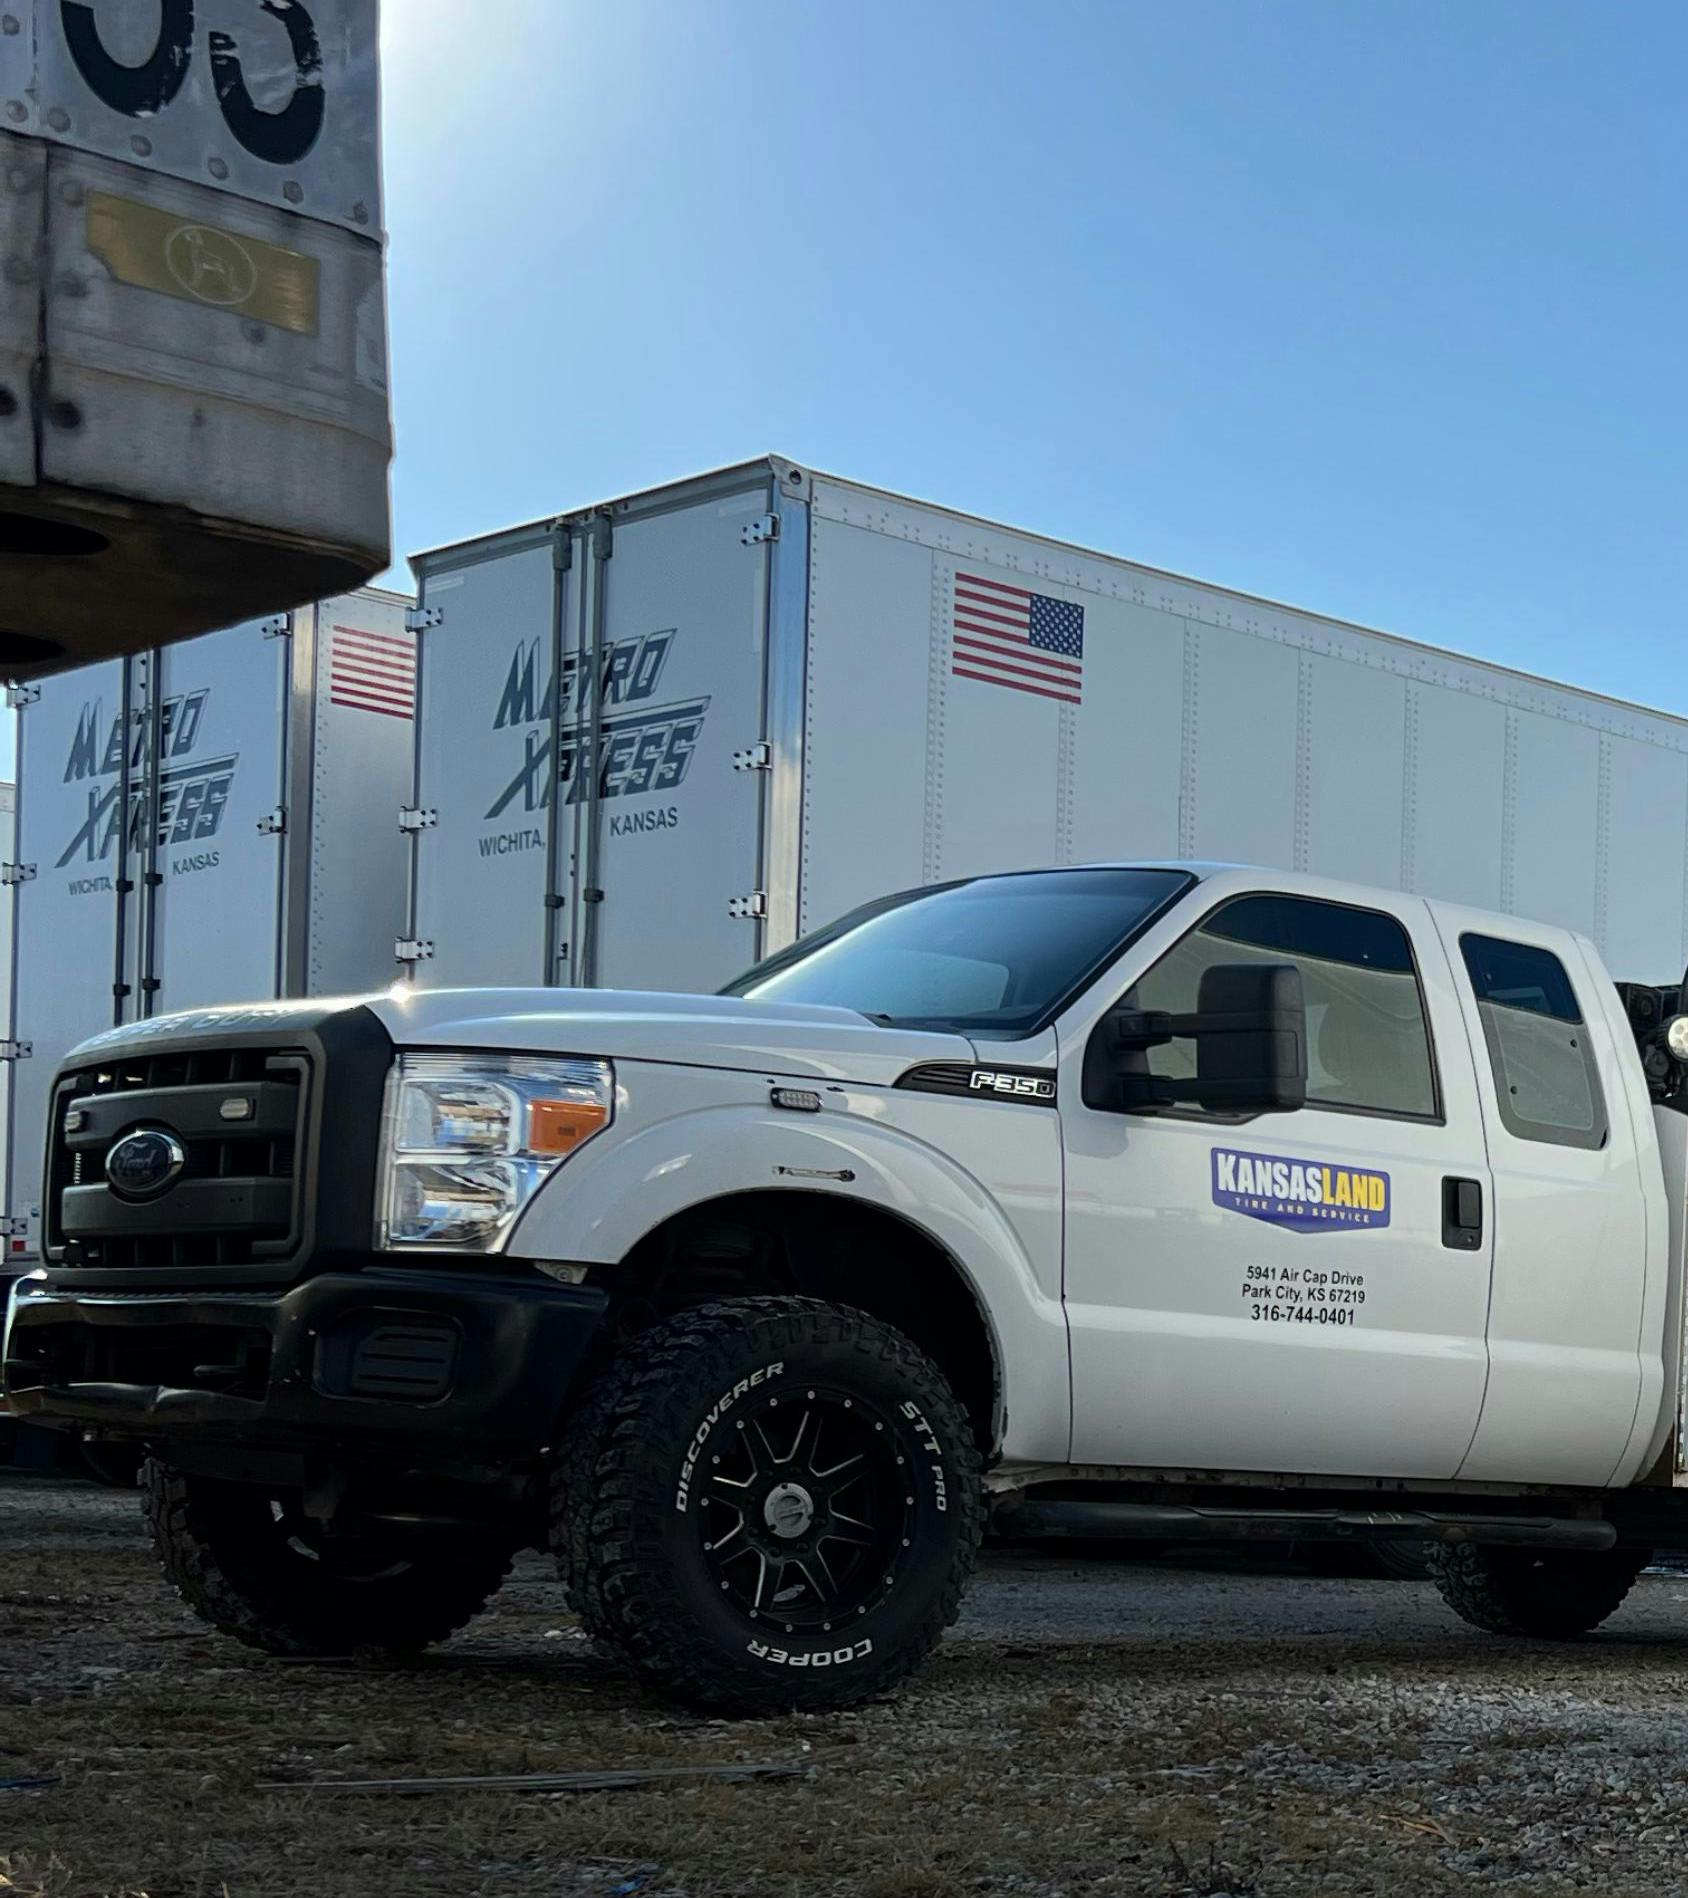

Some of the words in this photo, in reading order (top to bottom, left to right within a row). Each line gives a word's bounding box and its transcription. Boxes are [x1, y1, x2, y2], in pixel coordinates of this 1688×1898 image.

[609, 807, 678, 837] KANSAS
[172, 851, 220, 876] KANSAS
[1216, 1152, 1386, 1212] KANSASLAND
[1235, 1197, 1269, 1211] TIRE
[1277, 1202, 1304, 1215] AND
[1312, 1207, 1370, 1223] SERVICE
[1246, 1265, 1277, 1280] 5941
[1280, 1267, 1299, 1282] Air
[1303, 1269, 1327, 1285] Cap
[1331, 1270, 1364, 1286] Drive
[1241, 1284, 1271, 1299] Park
[1275, 1285, 1303, 1304] City,
[1307, 1287, 1326, 1301] KS
[1329, 1288, 1365, 1304] 67219
[1251, 1304, 1355, 1326] 316-744-0401
[675, 1361, 784, 1512] DISCOVERER
[899, 1400, 942, 1455] STT
[931, 1465, 947, 1511] PRO
[746, 1637, 873, 1667] COOPER
